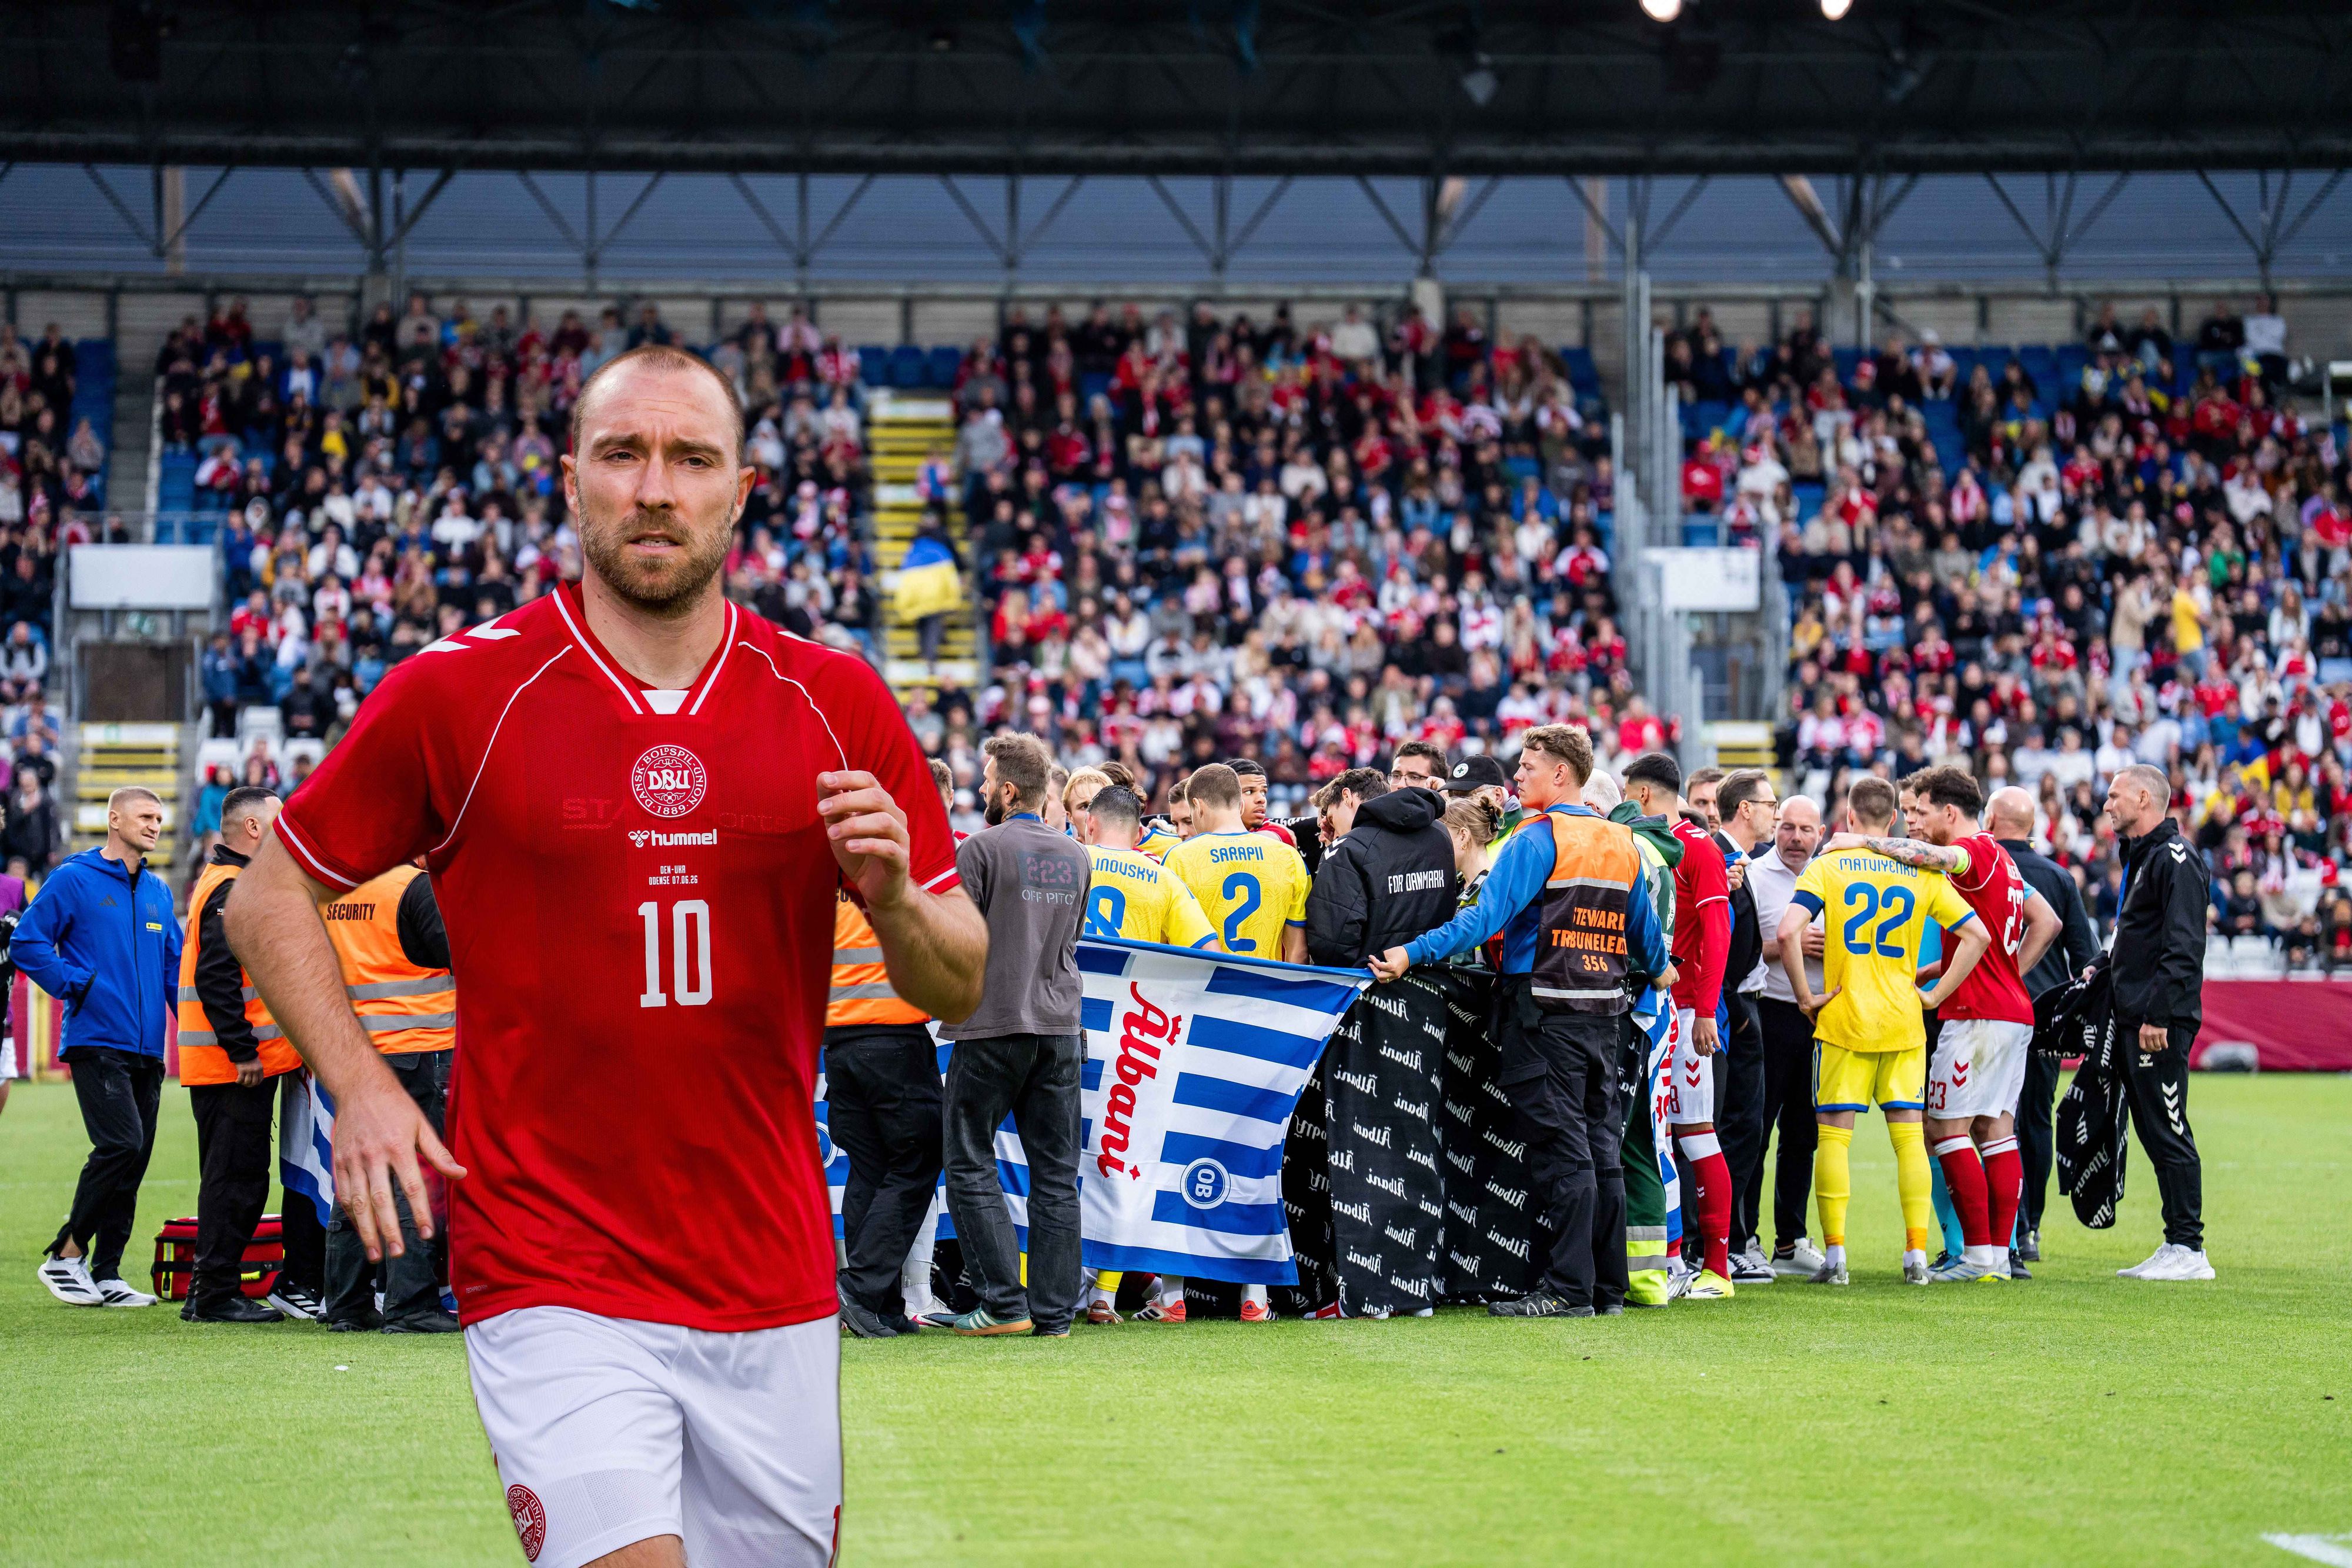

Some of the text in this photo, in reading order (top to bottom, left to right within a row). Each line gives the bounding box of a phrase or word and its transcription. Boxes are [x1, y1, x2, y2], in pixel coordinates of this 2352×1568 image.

[635, 765, 653, 808] DANSK
[647, 769, 690, 790] DBU
[656, 804, 686, 815] 1889
[651, 828, 717, 846] hummel
[1210, 846, 1264, 863] SARAPII
[649, 875, 698, 885] ODENSE 07.06.26
[660, 865, 686, 874] DEN-UKR
[1092, 858, 1158, 884] INOVSKYI
[1388, 870, 1445, 894] FOR DANMARK
[1022, 889, 1074, 905] OFF PITC
[327, 903, 376, 921] SECURITY
[1222, 872, 1261, 952] 2
[1844, 882, 1915, 958] 22
[638, 900, 712, 1007] 10
[1582, 954, 1608, 972] 356
[1929, 1080, 1946, 1110] 23
[1195, 1168, 1215, 1198] OB
